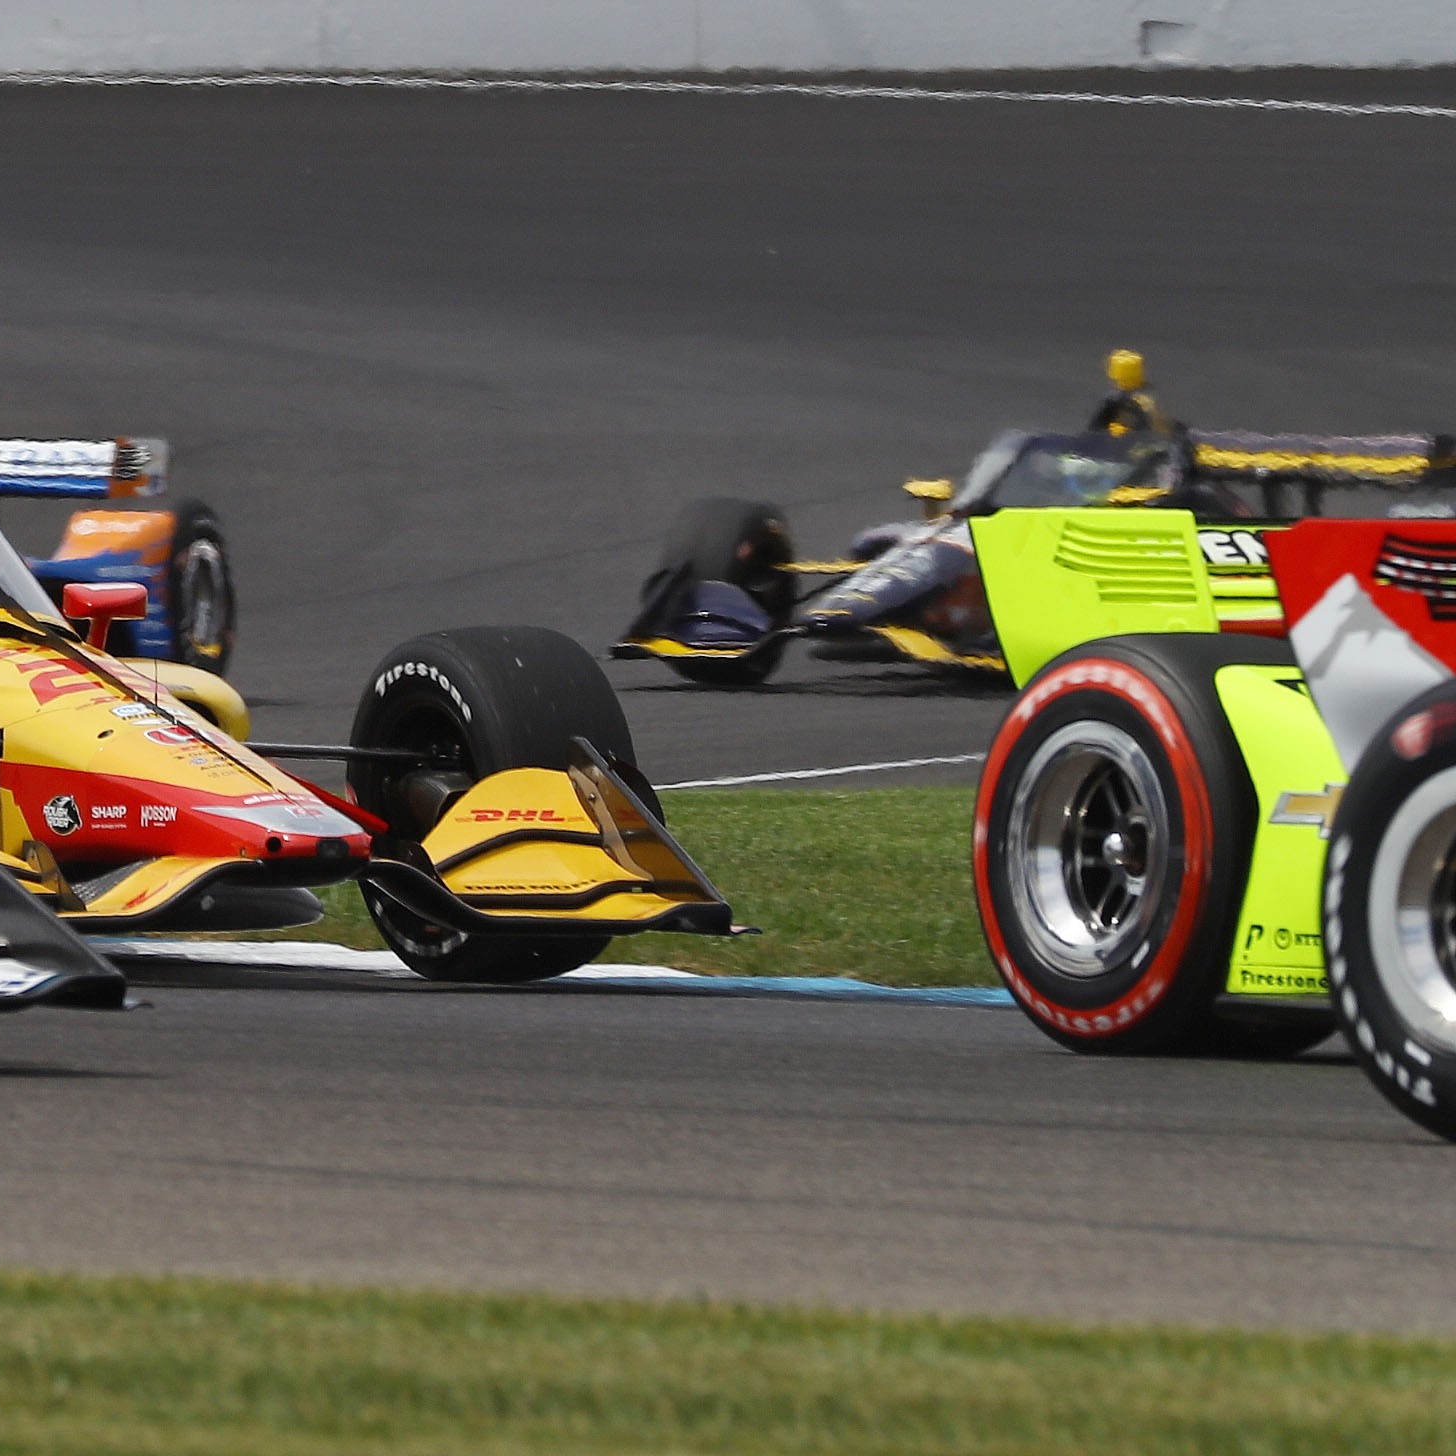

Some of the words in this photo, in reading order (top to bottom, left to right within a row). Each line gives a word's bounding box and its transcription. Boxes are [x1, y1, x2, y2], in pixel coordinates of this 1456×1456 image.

[375, 661, 472, 723] Firestone
[91, 805, 127, 819] SHARP
[471, 809, 566, 823] DHL
[1241, 970, 1328, 989] Firestone
